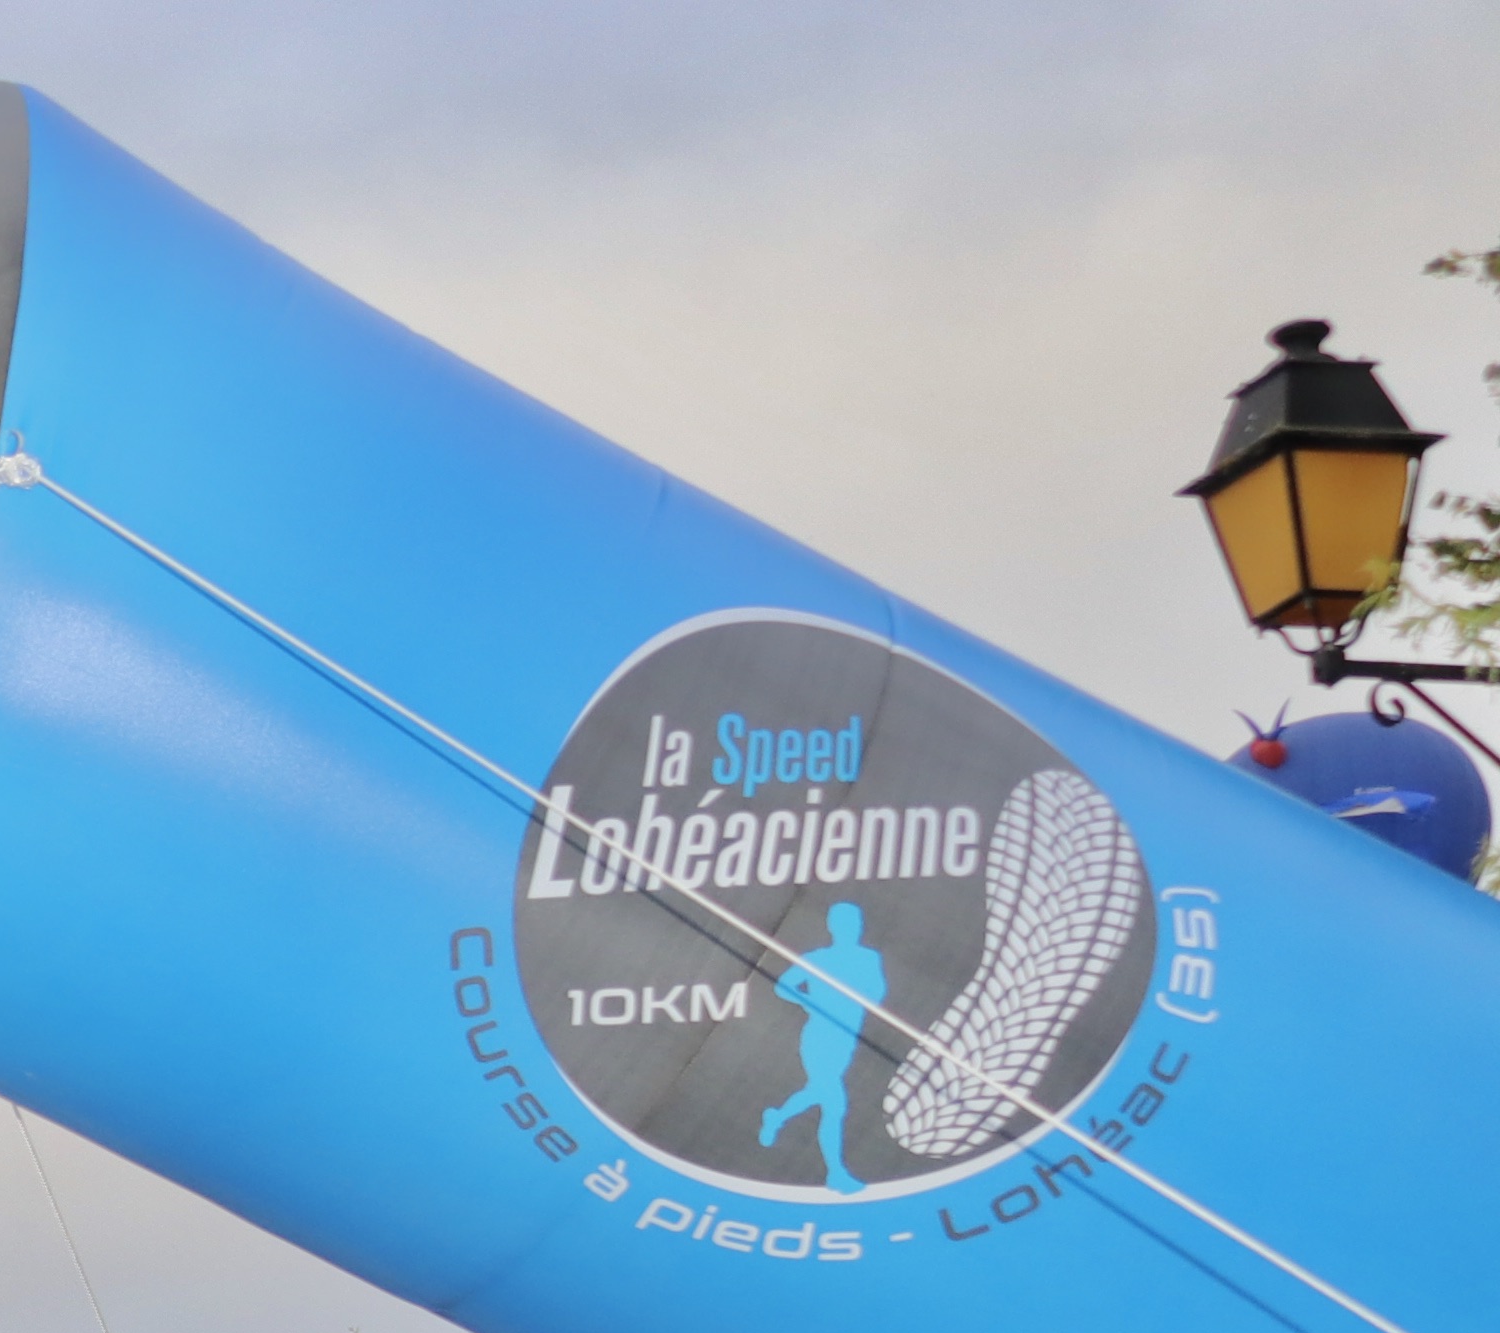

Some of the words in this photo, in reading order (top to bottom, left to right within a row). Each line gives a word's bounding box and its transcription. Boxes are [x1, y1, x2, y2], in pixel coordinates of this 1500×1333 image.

[642, 713, 691, 788] la
[713, 713, 862, 798] Speed
[527, 783, 981, 900] Lohéacienne
[568, 981, 749, 1027] 10KM
[448, 926, 580, 1164] Course
[583, 1158, 631, 1203] à
[938, 1042, 1190, 1243] Lohéac
[1156, 887, 1220, 1023] (35)
